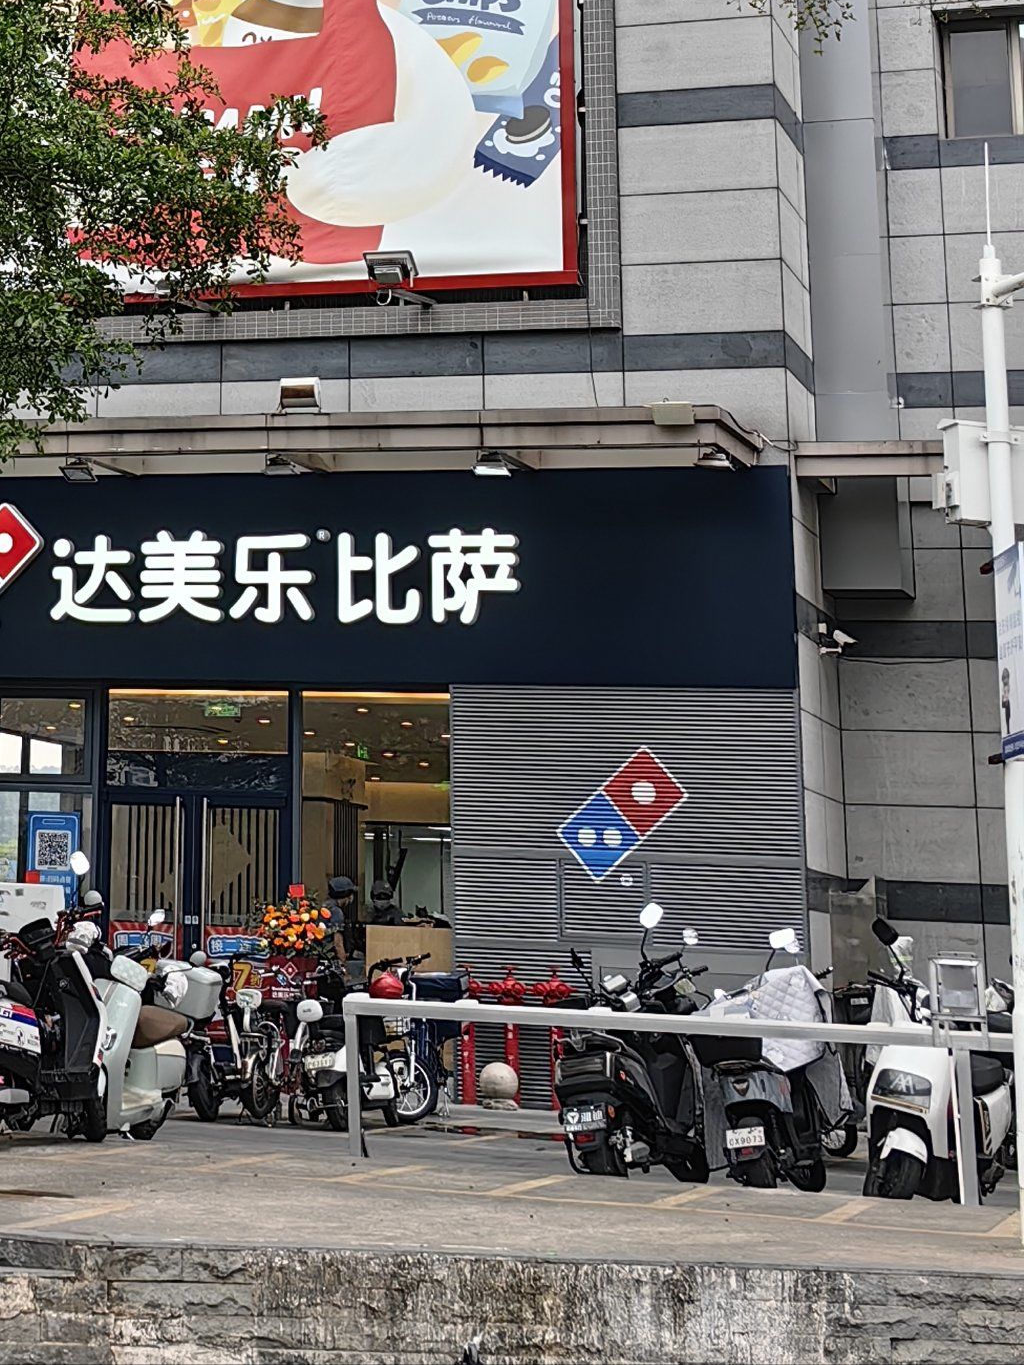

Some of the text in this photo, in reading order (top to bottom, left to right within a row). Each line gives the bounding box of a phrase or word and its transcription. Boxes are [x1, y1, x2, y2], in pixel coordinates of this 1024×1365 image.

[49, 527, 522, 626] 达美乐比萨
